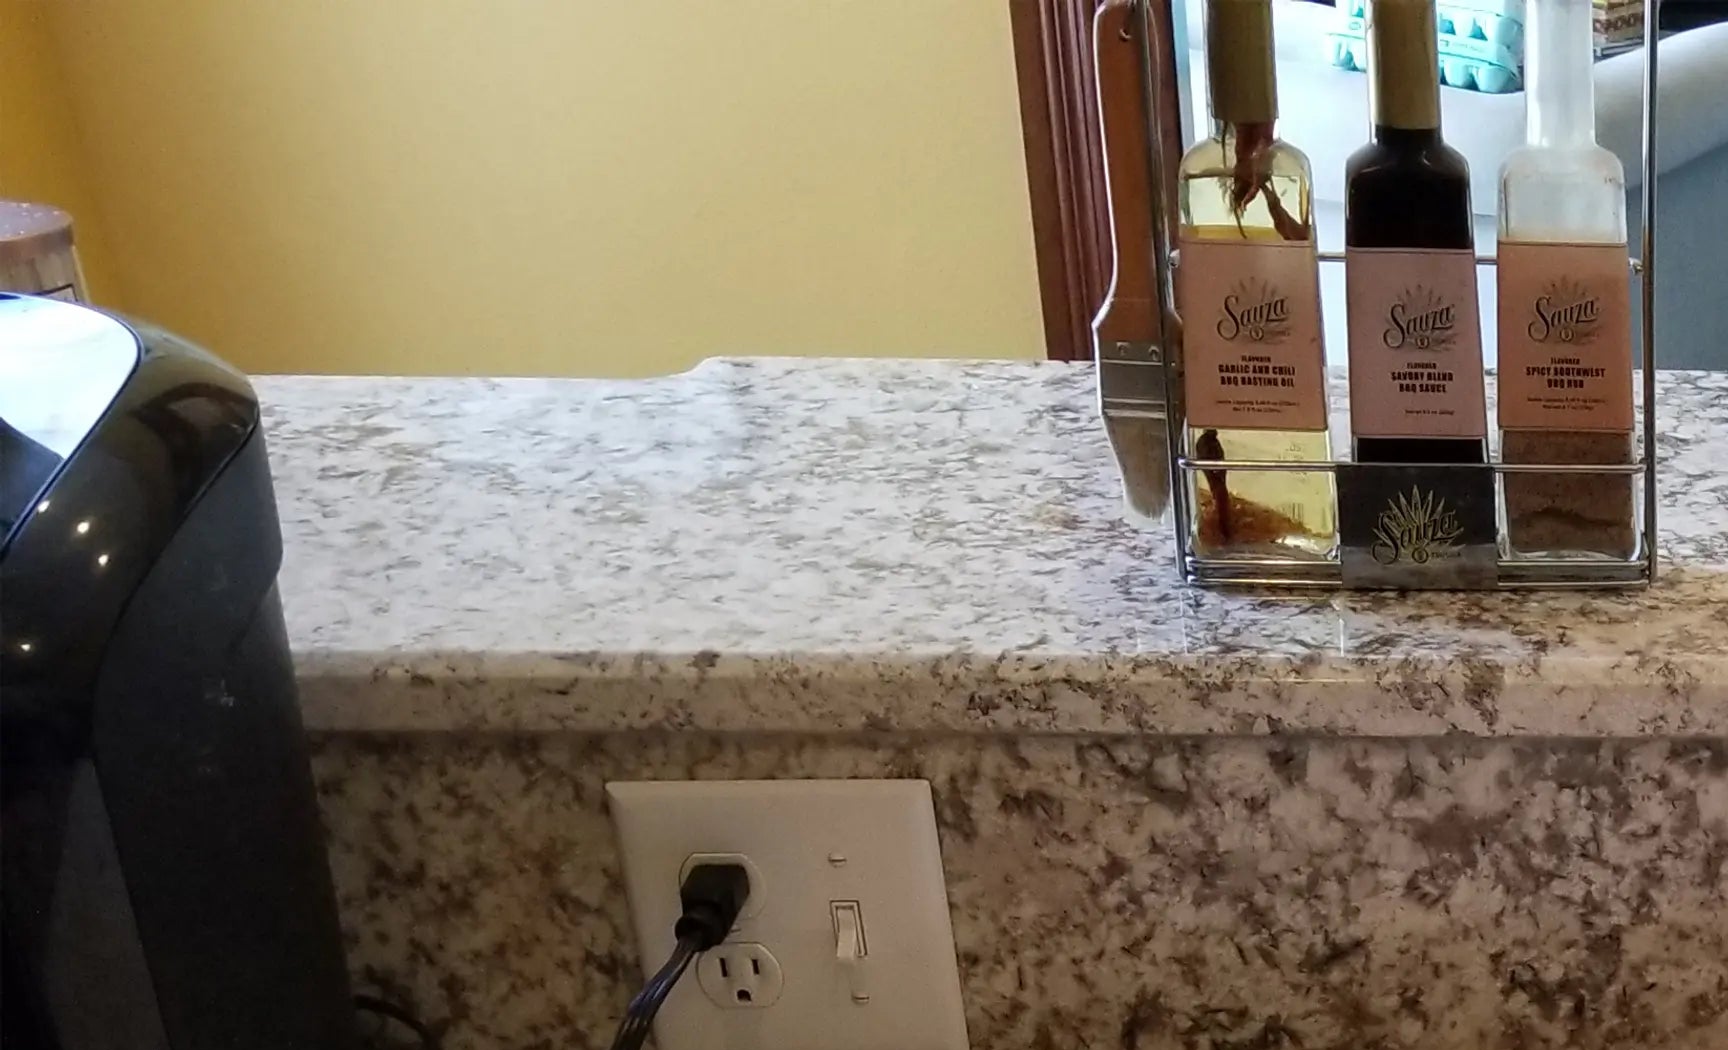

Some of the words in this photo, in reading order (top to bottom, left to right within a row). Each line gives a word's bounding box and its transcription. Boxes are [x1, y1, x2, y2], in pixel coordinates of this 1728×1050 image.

[1217, 295, 1288, 341] Sauza
[1528, 296, 1598, 343] Sauza
[1383, 304, 1453, 349] Sauza
[1218, 364, 1250, 374] GARLIC
[1252, 365, 1270, 375] AND
[1272, 366, 1295, 376] CHILI
[1526, 366, 1552, 376] SPICY
[1553, 366, 1605, 377] SOUTHWEST
[1220, 376, 1239, 387] BBQ
[1241, 376, 1279, 387] BASTING
[1281, 377, 1295, 388] OIL
[1391, 371, 1424, 381] SAVORY
[1427, 372, 1453, 382] BLEND
[1399, 384, 1417, 393] BBQ
[1419, 384, 1446, 393] SAUCE
[1371, 512, 1457, 565] Sauza
